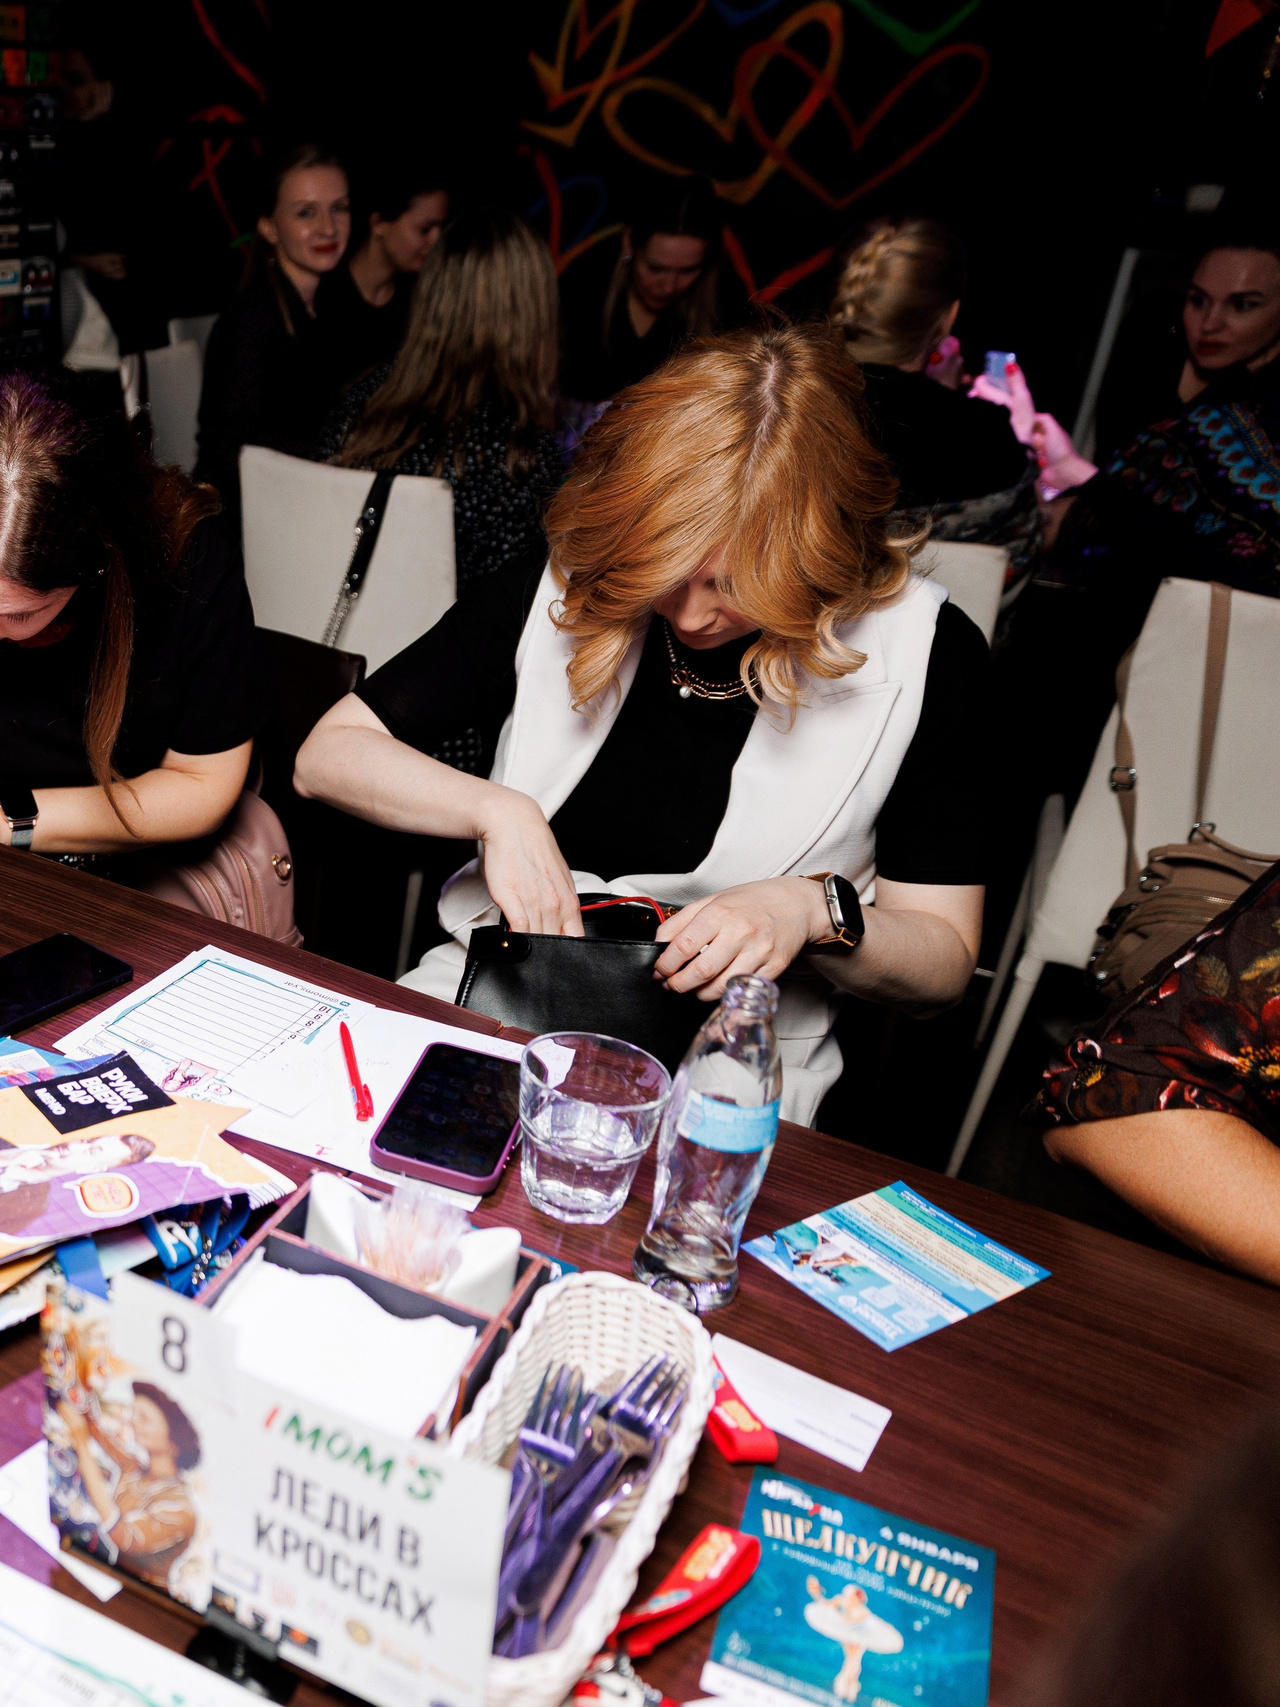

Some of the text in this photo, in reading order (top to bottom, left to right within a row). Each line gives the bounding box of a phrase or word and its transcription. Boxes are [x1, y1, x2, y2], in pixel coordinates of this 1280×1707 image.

[318, 1005, 332, 1014] 10
[34, 1087, 67, 1116] МЕНЮ
[57, 1081, 95, 1105] БАР
[78, 1075, 134, 1115] ВВЕРХ
[100, 1066, 149, 1103] РУКИ
[160, 1315, 188, 1374] 8
[271, 1465, 422, 1570] ЛЕДИ В
[760, 1508, 974, 1611] ЩЕЛКУНЧИК
[897, 1531, 980, 1573] ЯНВАРЯ
[254, 1512, 438, 1635] КРОССАХ
